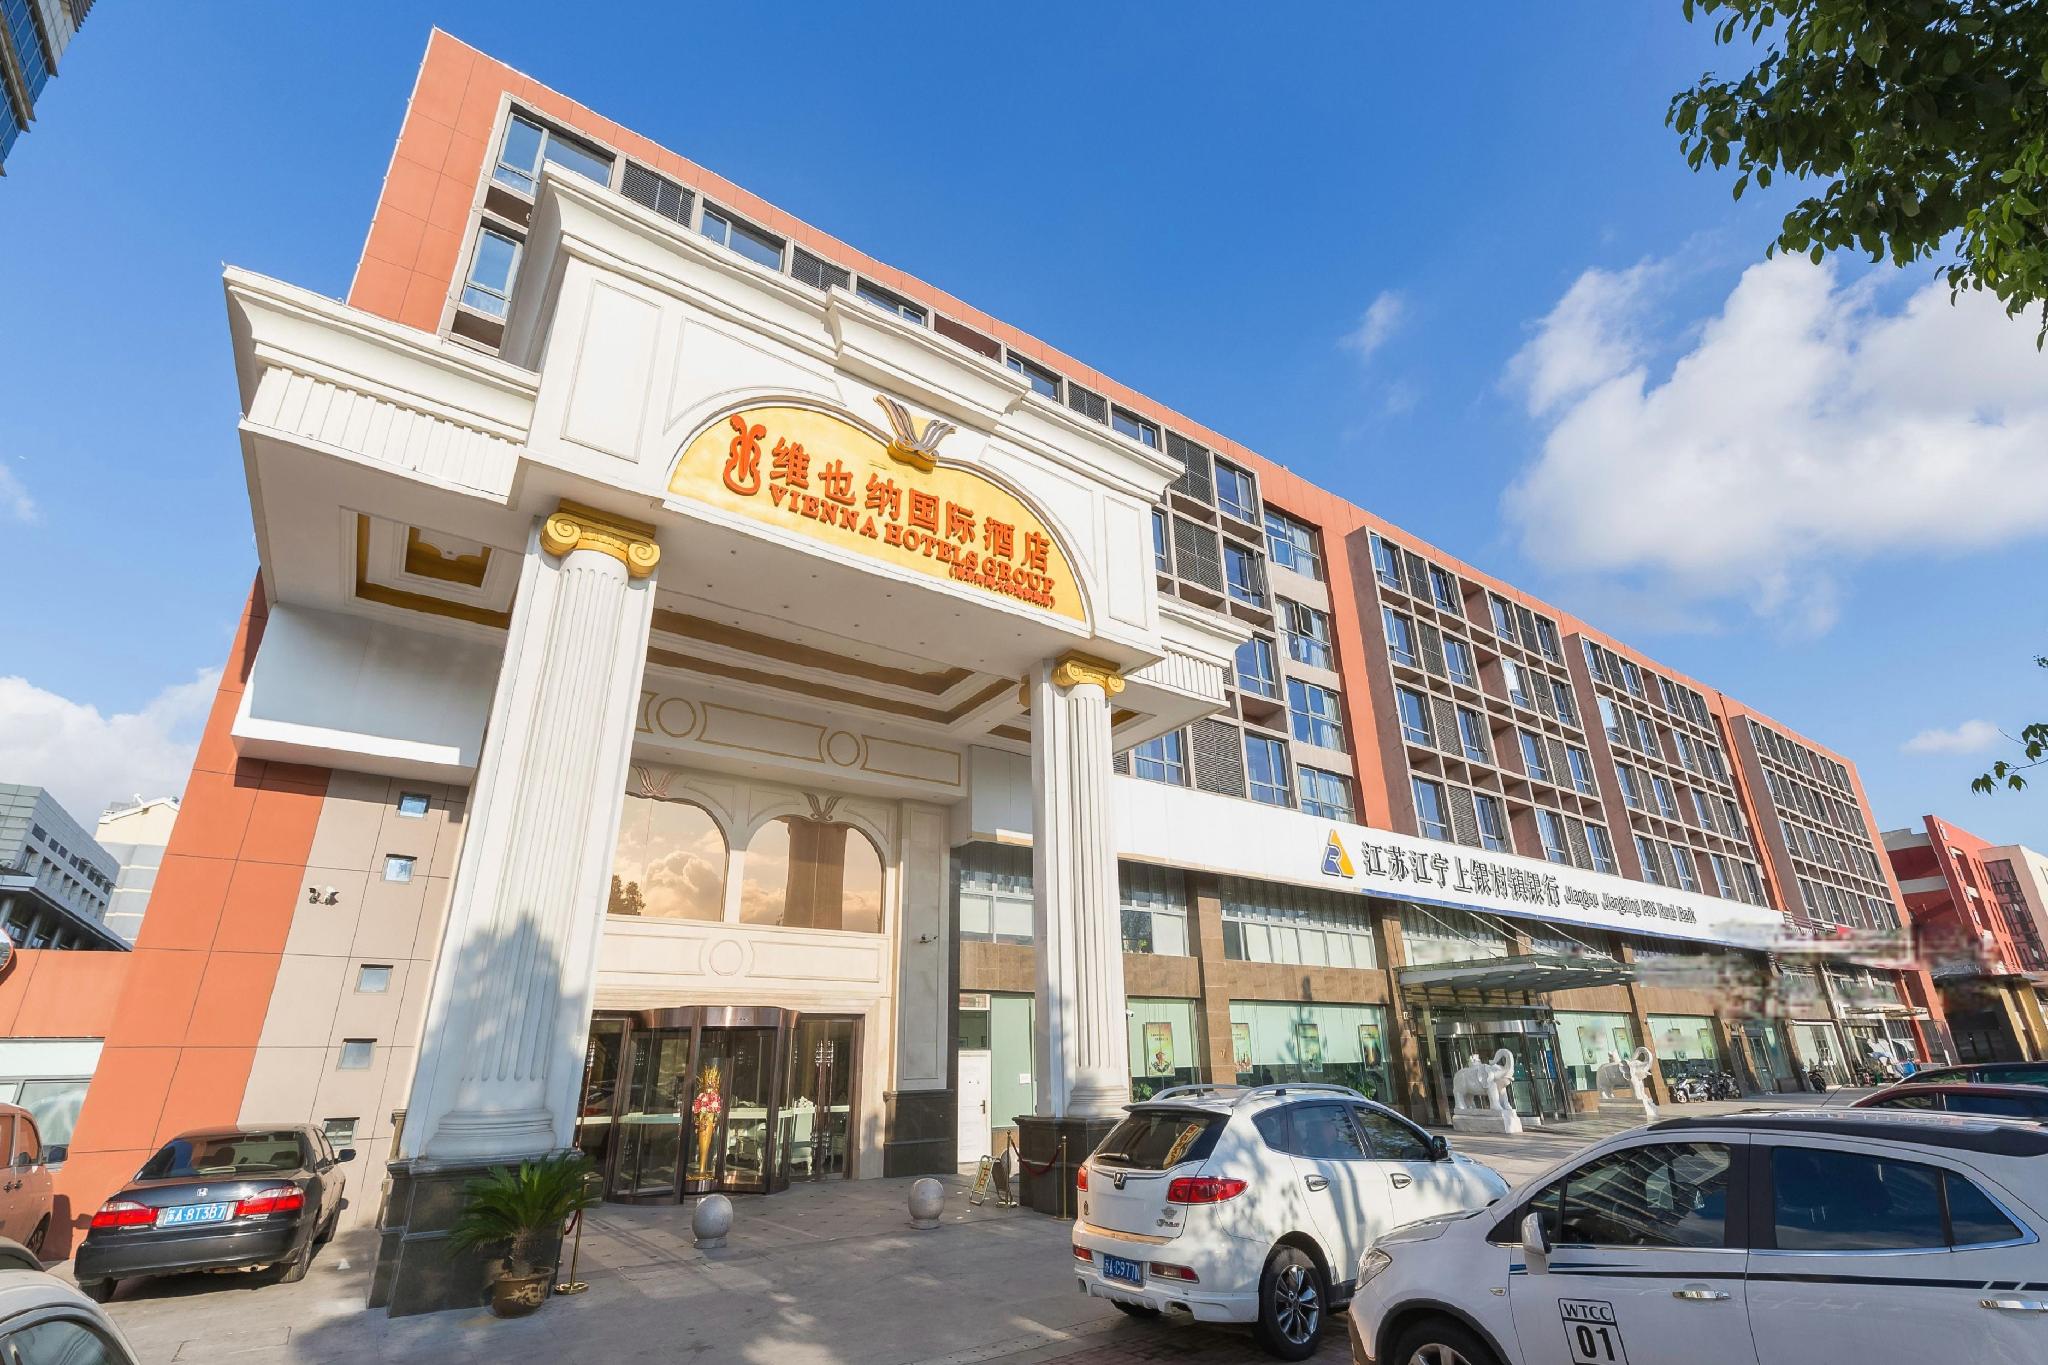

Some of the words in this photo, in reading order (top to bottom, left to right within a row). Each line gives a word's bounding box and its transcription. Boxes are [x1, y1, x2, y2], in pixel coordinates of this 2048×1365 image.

[770, 436, 1051, 575] 维也纳国际酒店
[769, 483, 878, 541] VIENNA
[884, 522, 978, 572] HOTELS
[982, 557, 1055, 594] GROUP
[1361, 841, 1560, 907] 江苏江宁上银村镇银行
[1564, 885, 1600, 910] Jiangsu
[1563, 1303, 1612, 1321] WTCC
[1576, 1325, 1616, 1361] 01
